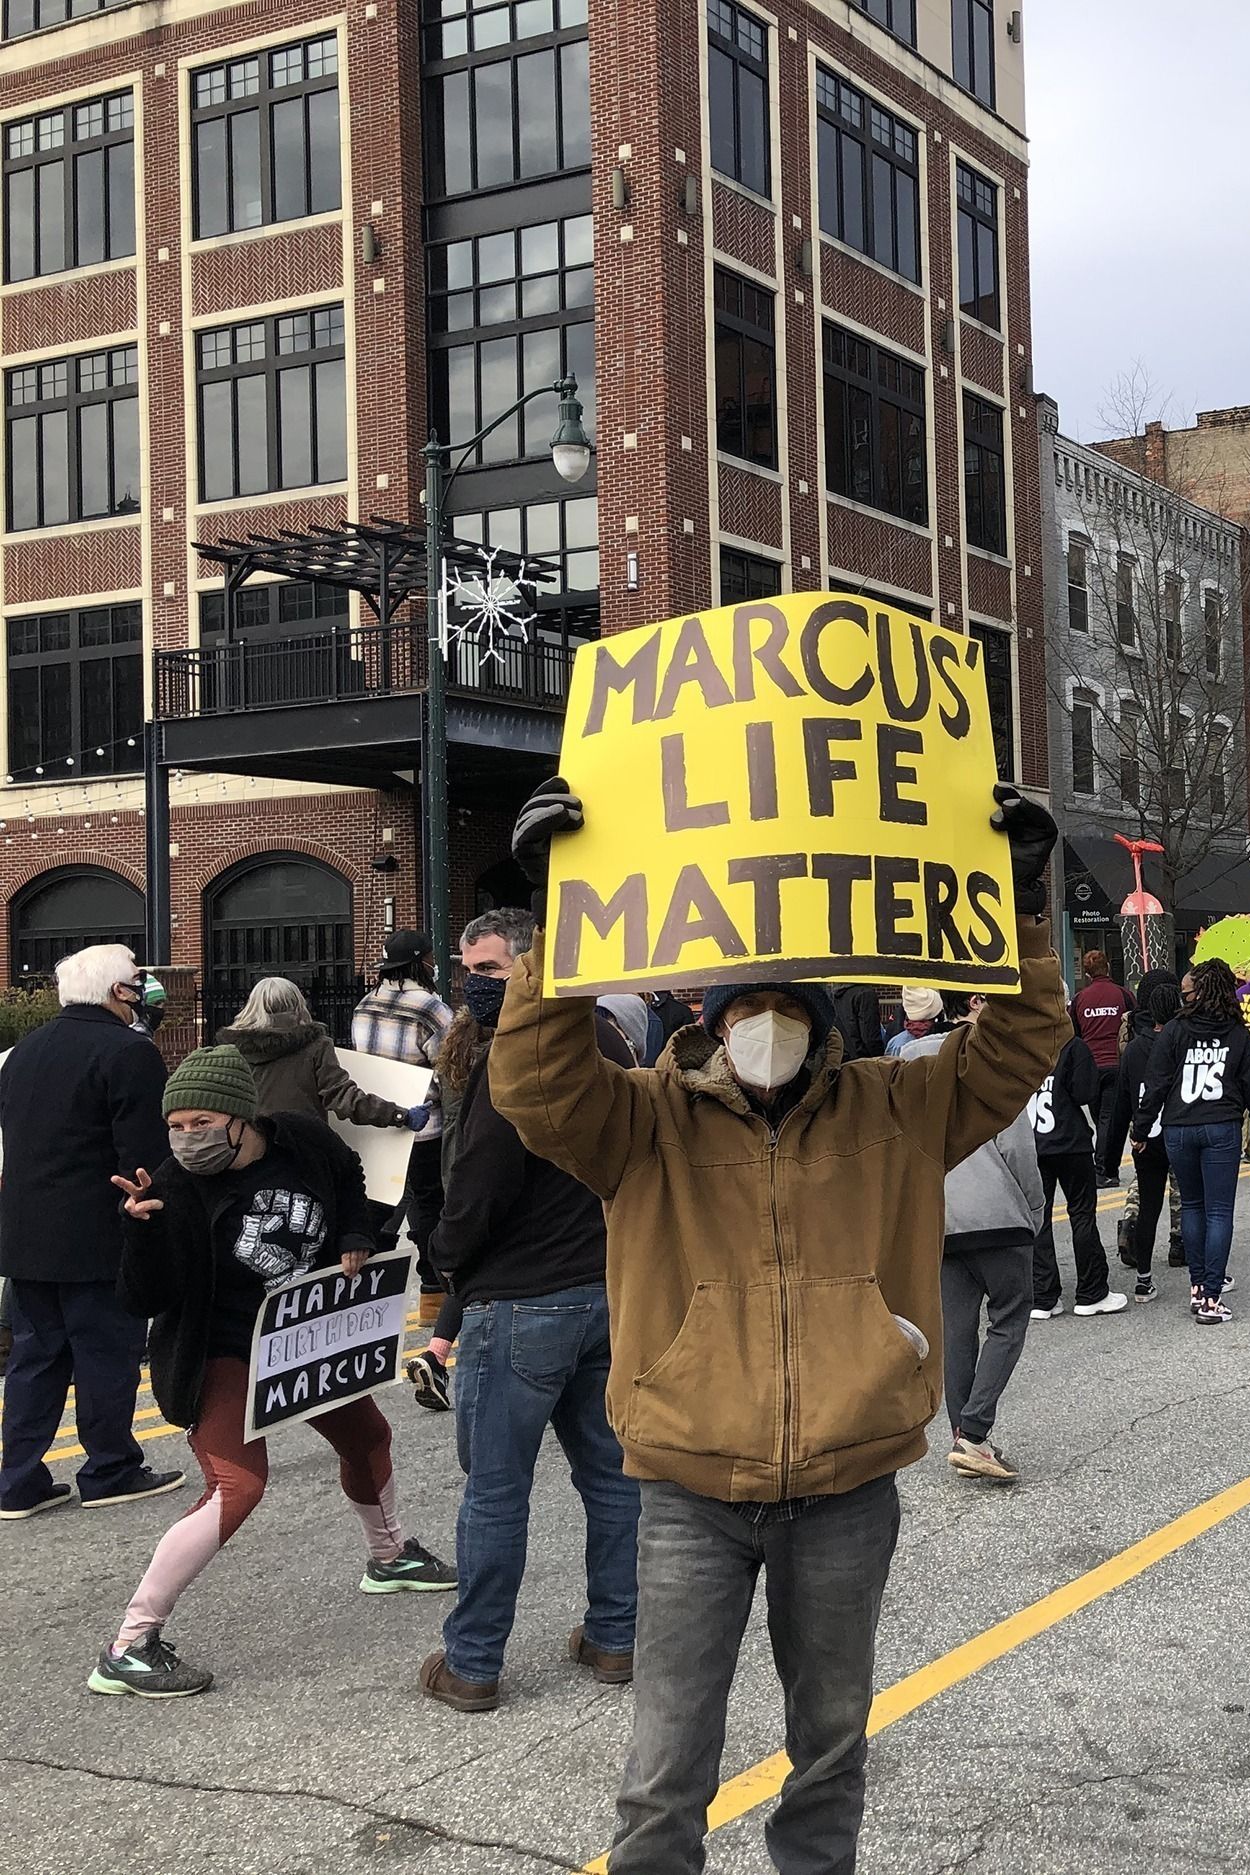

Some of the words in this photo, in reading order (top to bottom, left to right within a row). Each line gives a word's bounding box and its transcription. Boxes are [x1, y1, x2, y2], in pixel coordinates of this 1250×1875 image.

[581, 600, 982, 739] MARCUS'
[660, 717, 928, 833] LIFE
[553, 852, 1010, 979] MATTERS
[1073, 916, 1110, 924] Restoration
[1180, 1061, 1226, 1104] US
[1184, 1046, 1230, 1064] ABOUT
[235, 1215, 262, 1259] HISTORY
[290, 1199, 309, 1226] HOPE
[274, 1268, 386, 1328] HAPPY
[267, 1301, 390, 1368] BIRTHDAY
[264, 1345, 387, 1414] MARCUS
